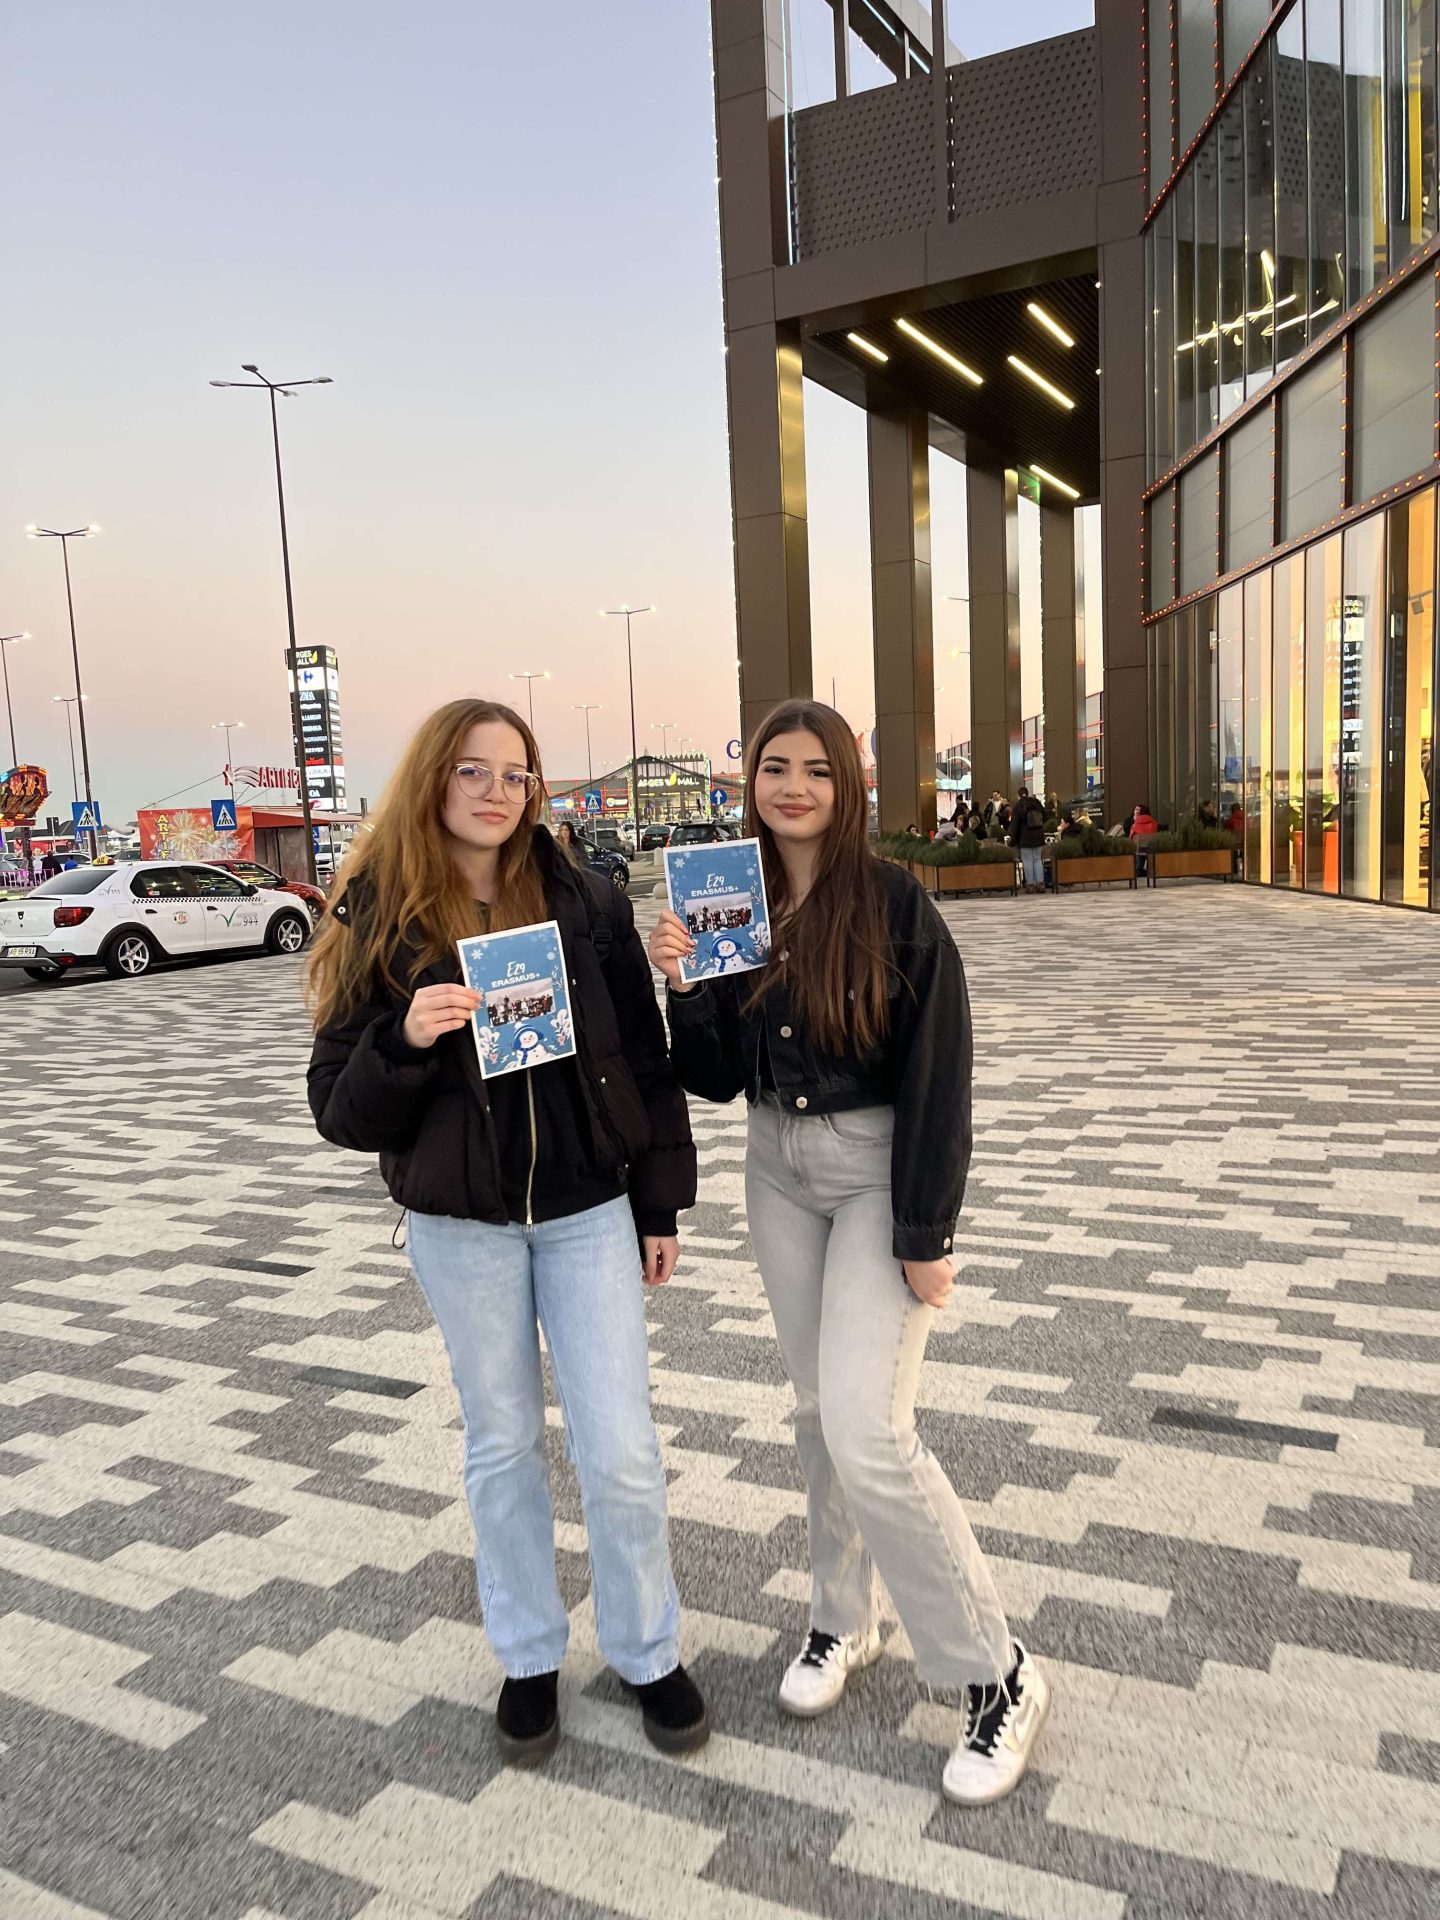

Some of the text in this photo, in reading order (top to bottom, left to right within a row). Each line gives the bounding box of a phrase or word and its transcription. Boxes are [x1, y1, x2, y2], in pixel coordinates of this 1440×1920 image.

[296, 650, 312, 658] RGES
[297, 657, 309, 665] ALL
[677, 777, 700, 786] MALL
[706, 873, 725, 888] E29
[691, 885, 739, 897] ERASMUS+
[491, 972, 541, 988] ERASMUS+
